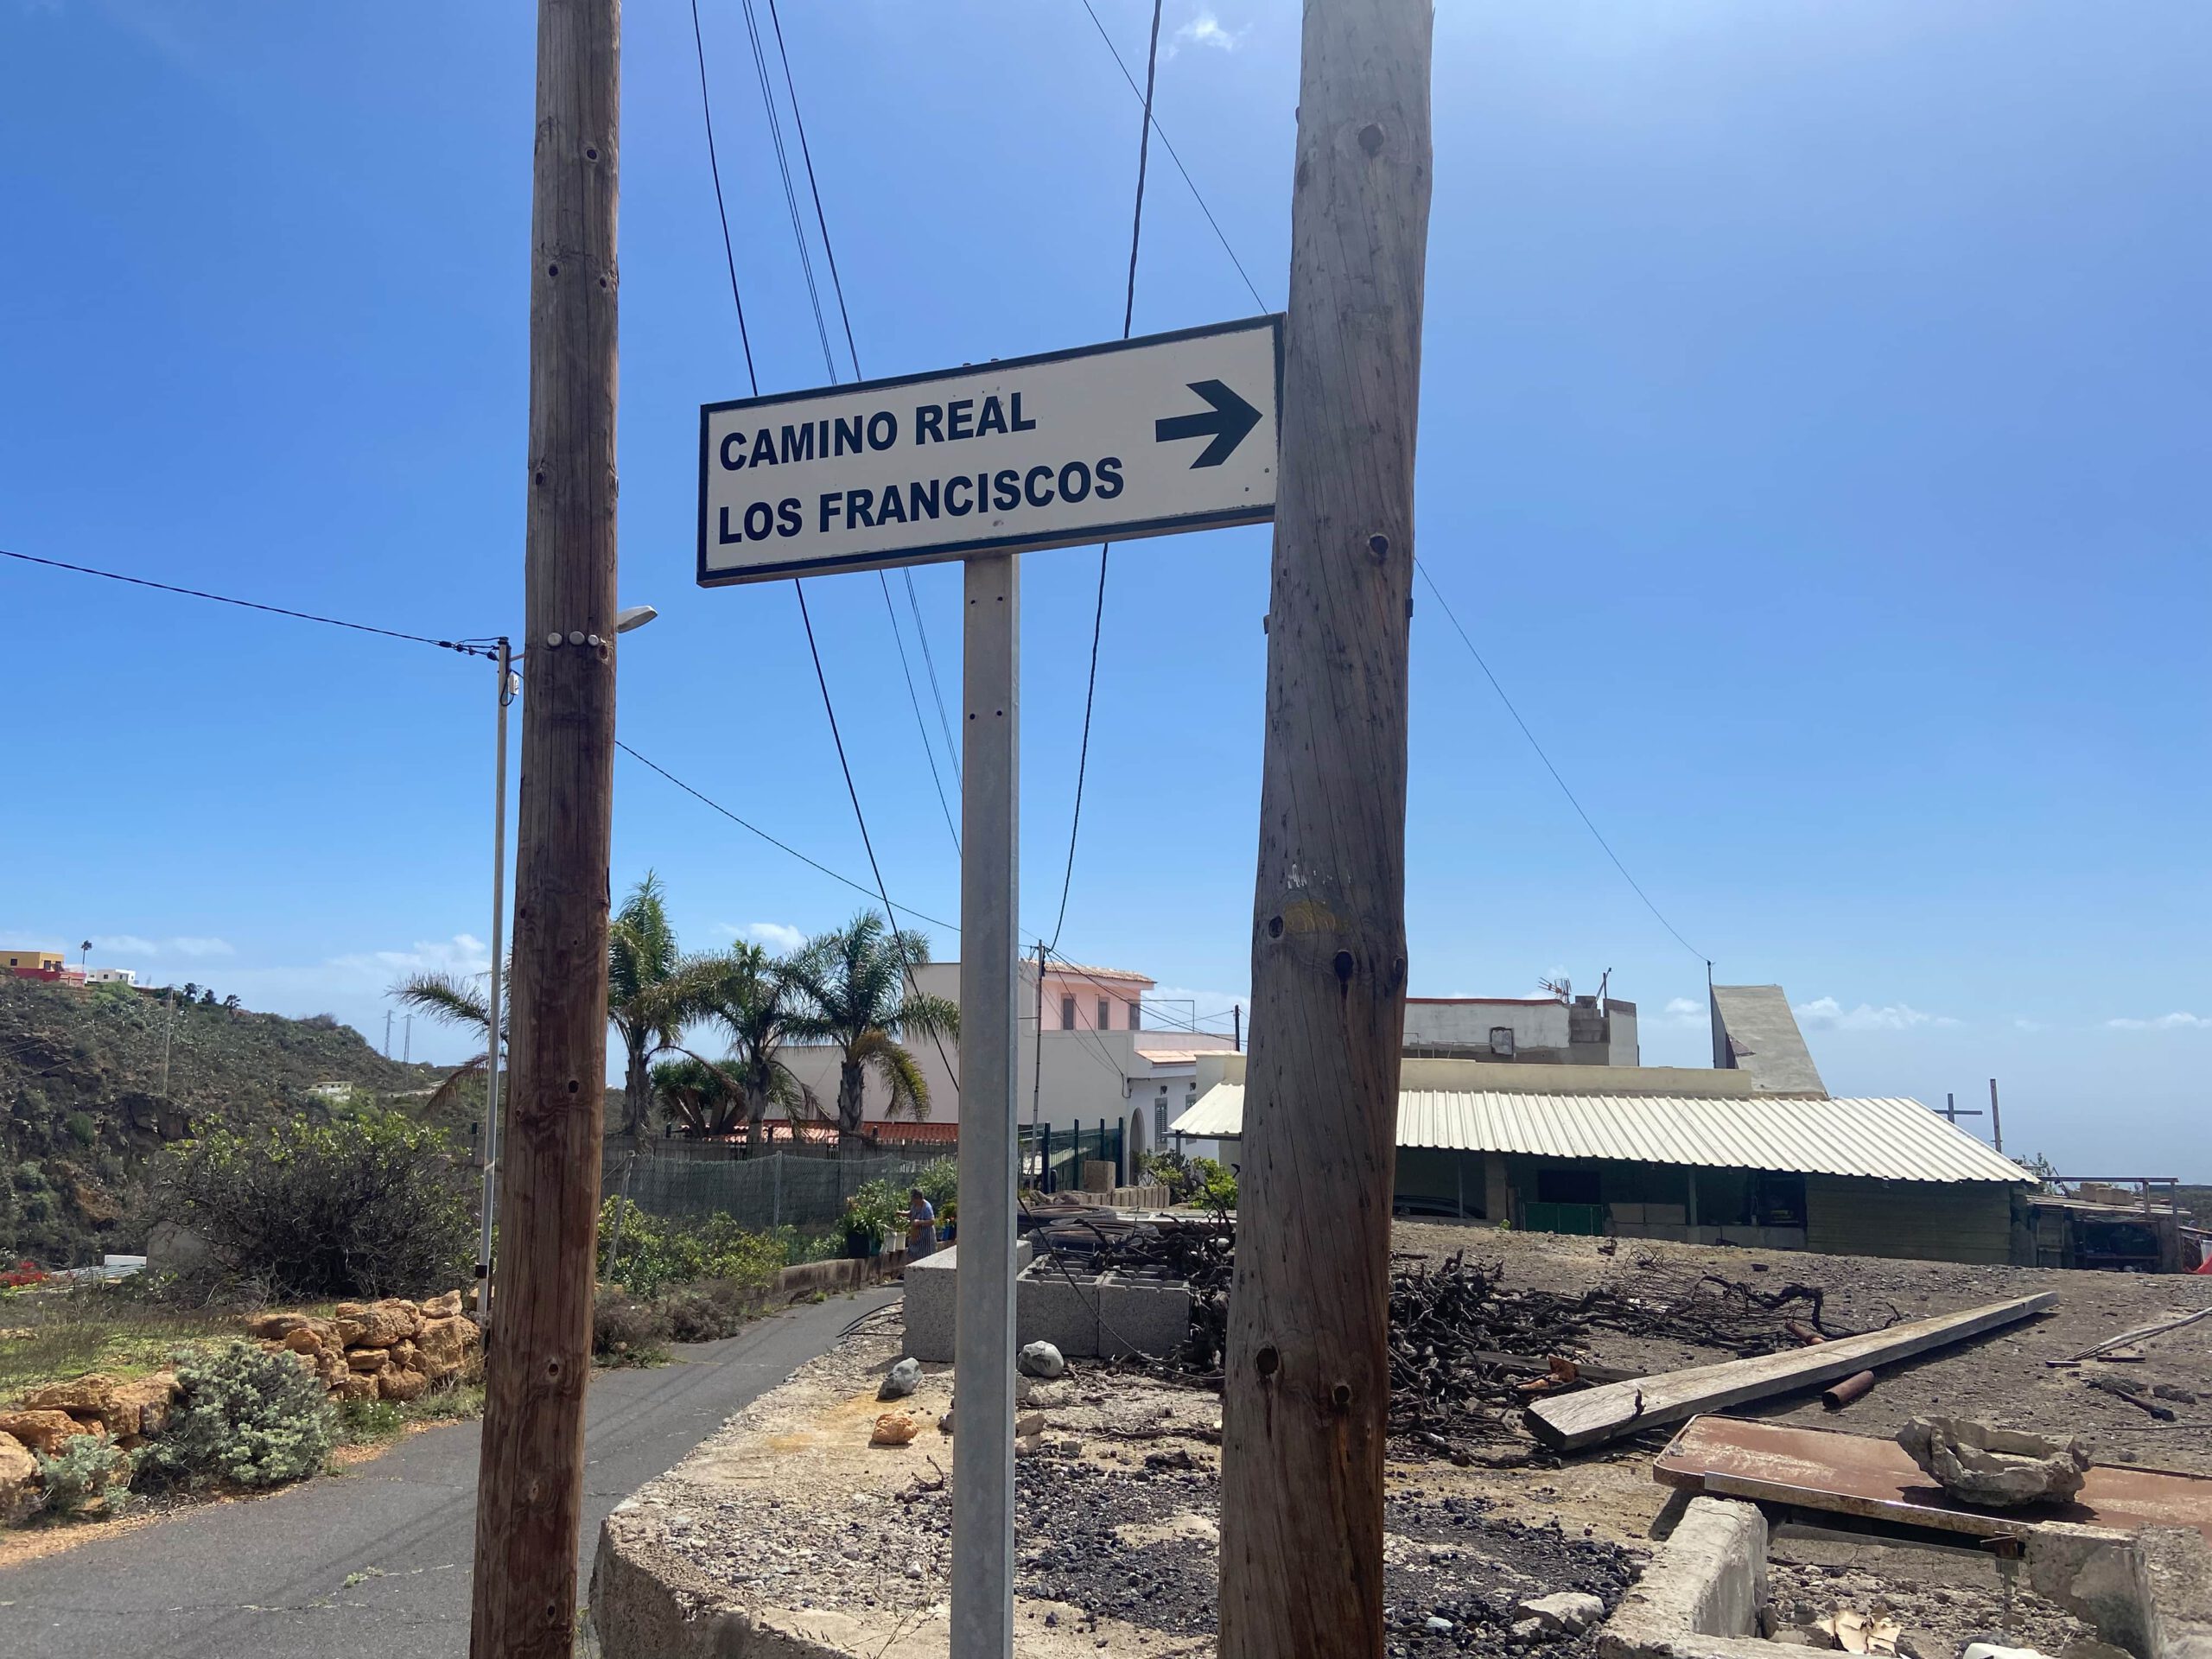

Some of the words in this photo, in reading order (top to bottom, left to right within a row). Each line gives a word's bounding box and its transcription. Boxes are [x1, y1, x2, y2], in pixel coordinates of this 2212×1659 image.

[719, 410, 898, 472] CAMINO
[915, 391, 1037, 446] REAL
[718, 497, 803, 545] LOS
[819, 456, 1124, 533] FRANCISCOS
